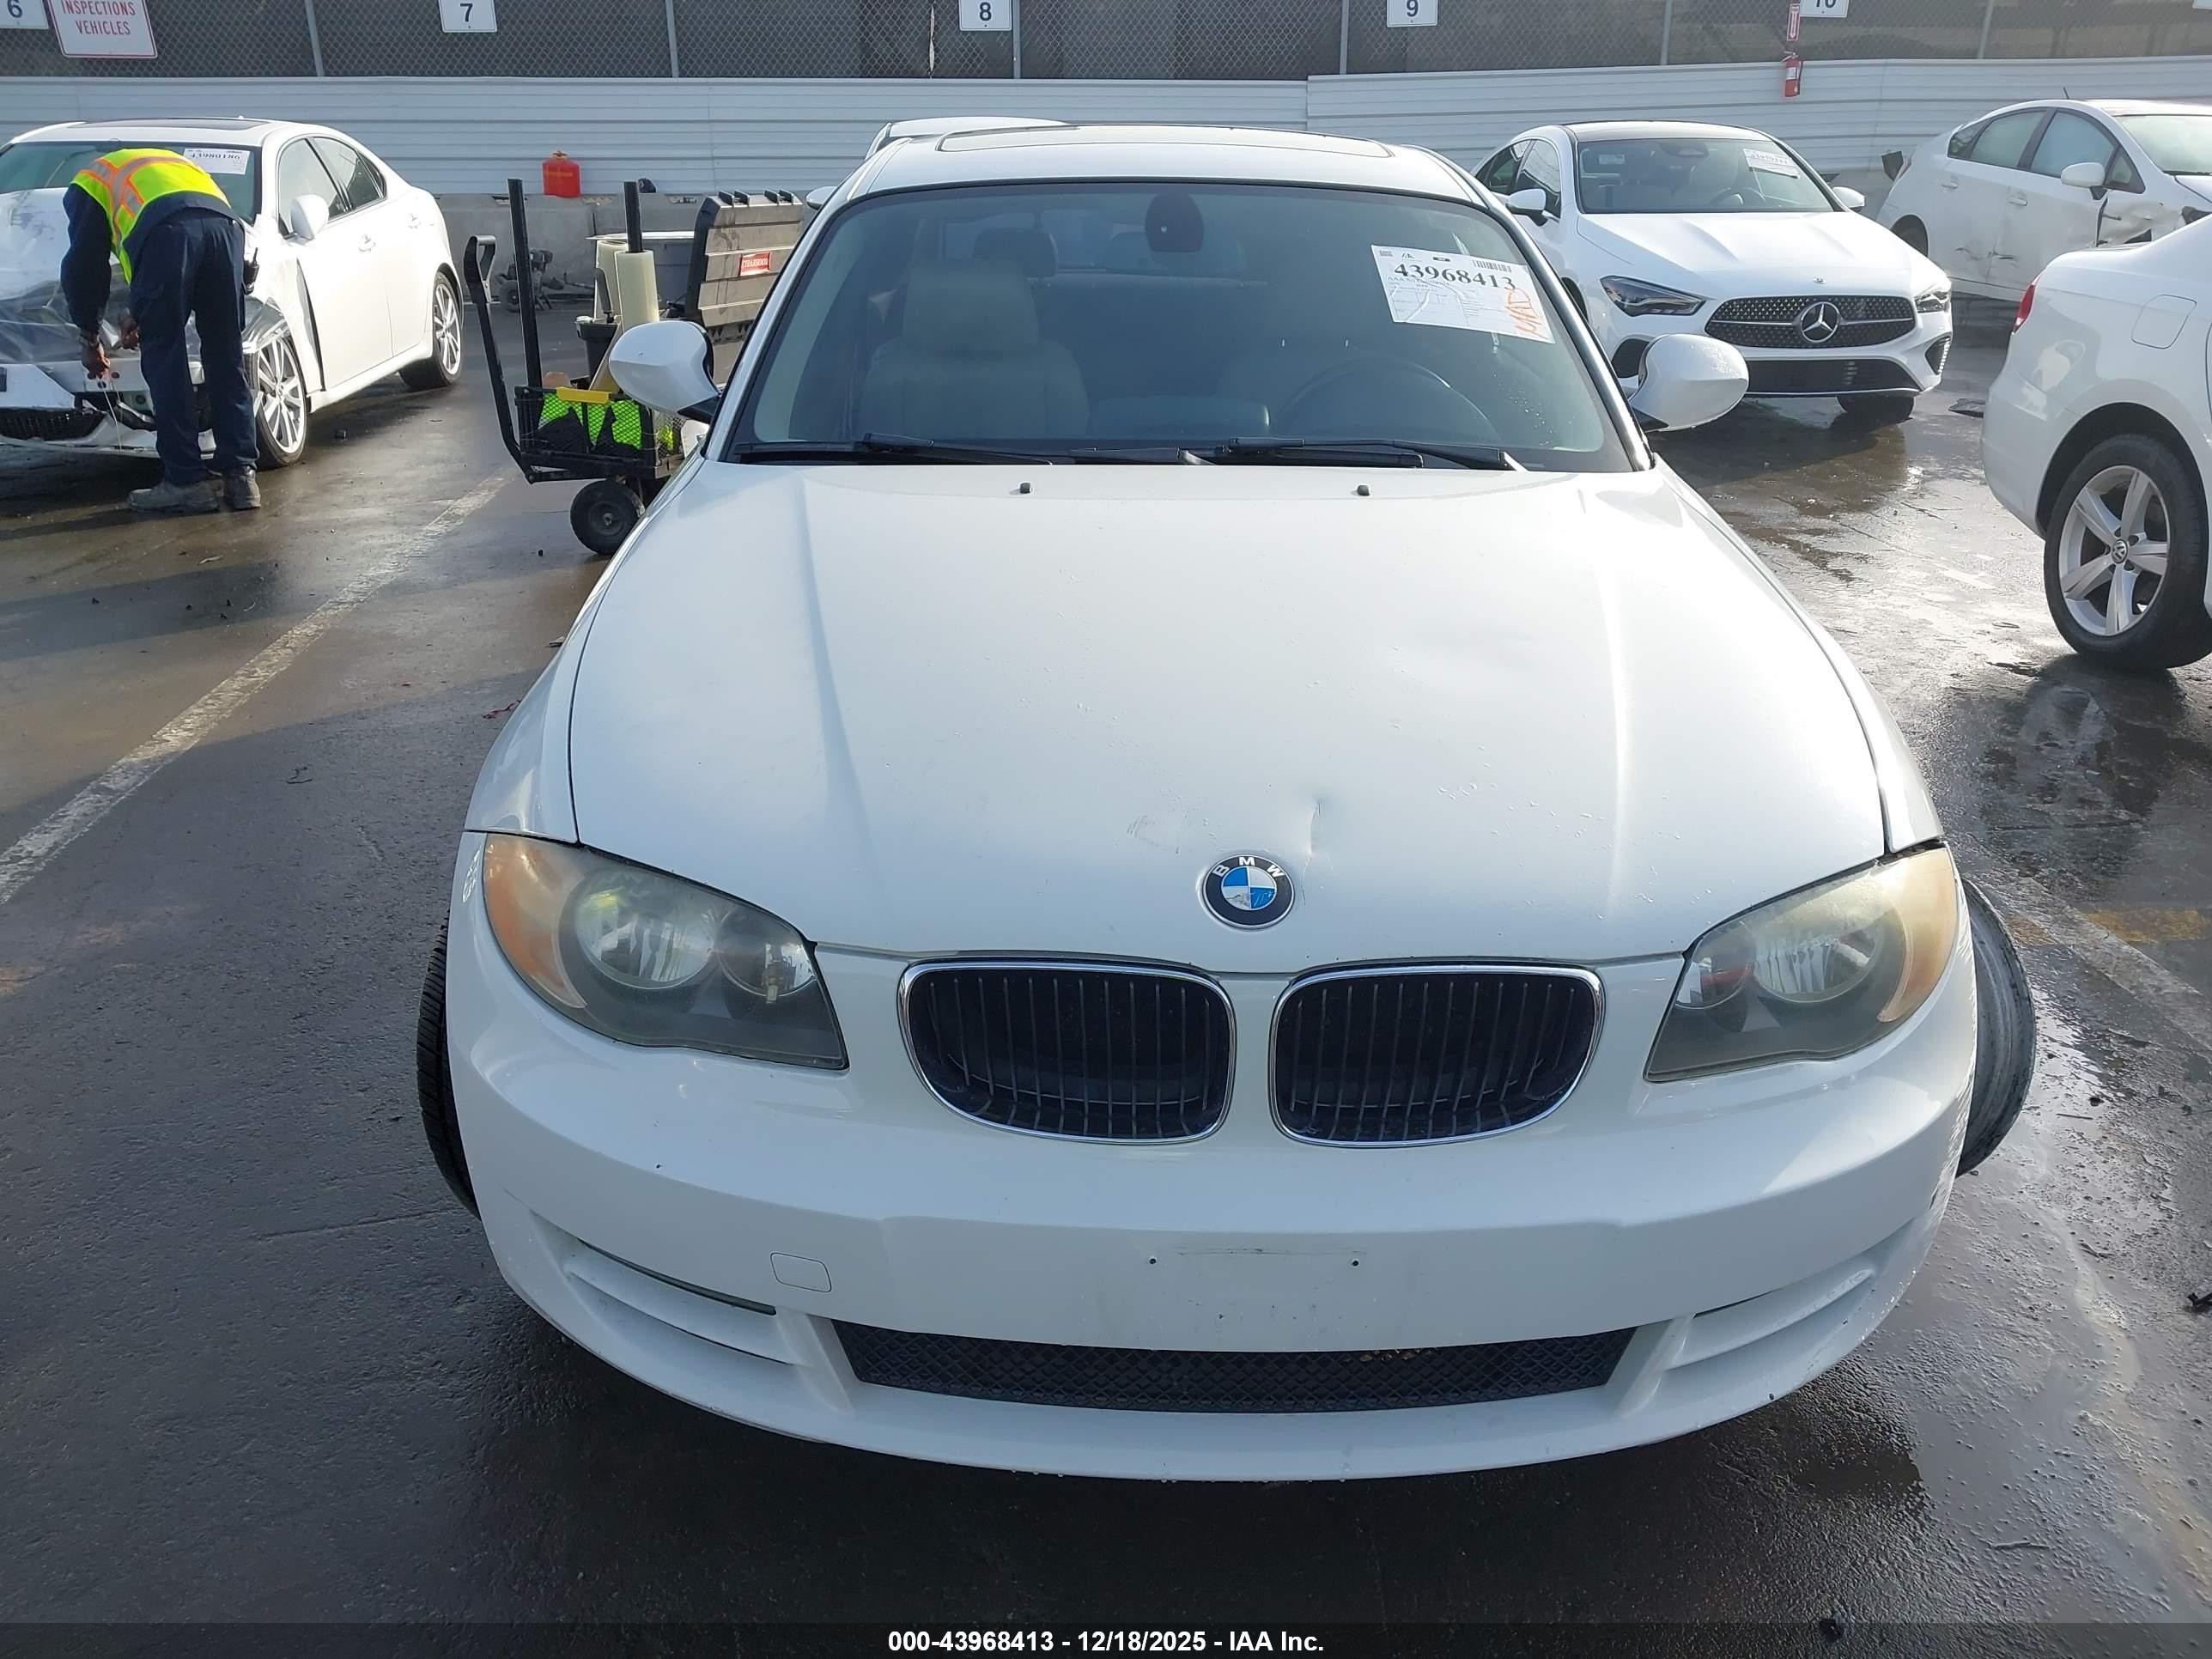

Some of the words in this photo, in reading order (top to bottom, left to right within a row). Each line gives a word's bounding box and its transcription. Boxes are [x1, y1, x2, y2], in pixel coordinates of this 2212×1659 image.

[7, 0, 23, 18] 6
[63, 0, 136, 15] INSPECTIONS
[459, 3, 473, 22] 7
[979, 2, 992, 21] 8
[1407, 0, 1419, 17] 9
[76, 21, 131, 35] VEHICLES
[1394, 263, 1516, 292] 43968413
[1212, 856, 1285, 878] BMW
